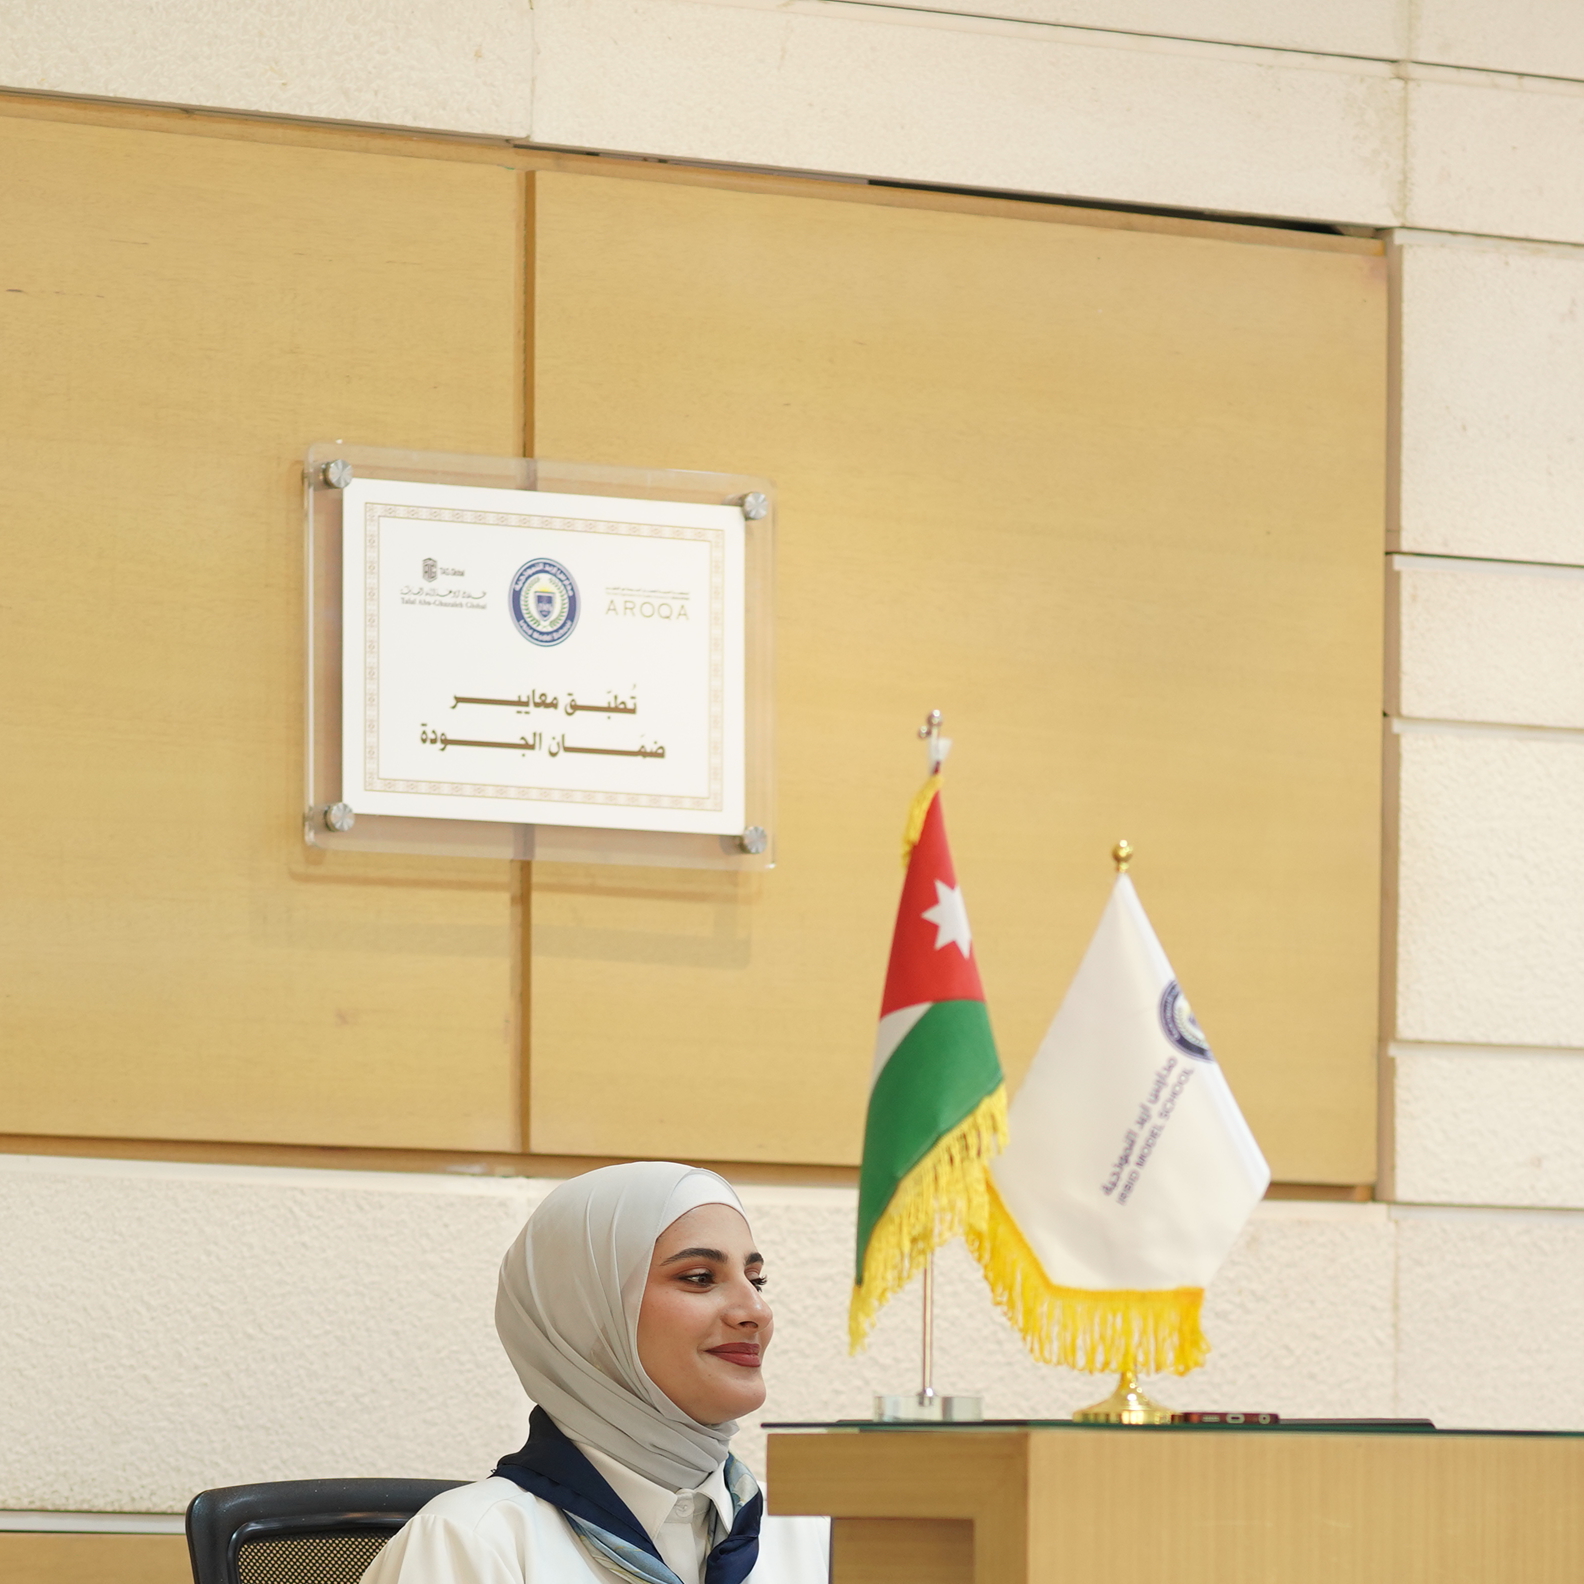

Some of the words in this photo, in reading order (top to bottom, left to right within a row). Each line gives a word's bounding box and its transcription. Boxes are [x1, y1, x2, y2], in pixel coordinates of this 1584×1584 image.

[605, 600, 690, 620] AROQA
[421, 722, 543, 758] الجودة
[1136, 1124, 1165, 1169] MODEL
[1159, 1067, 1194, 1120] SCHOOL
